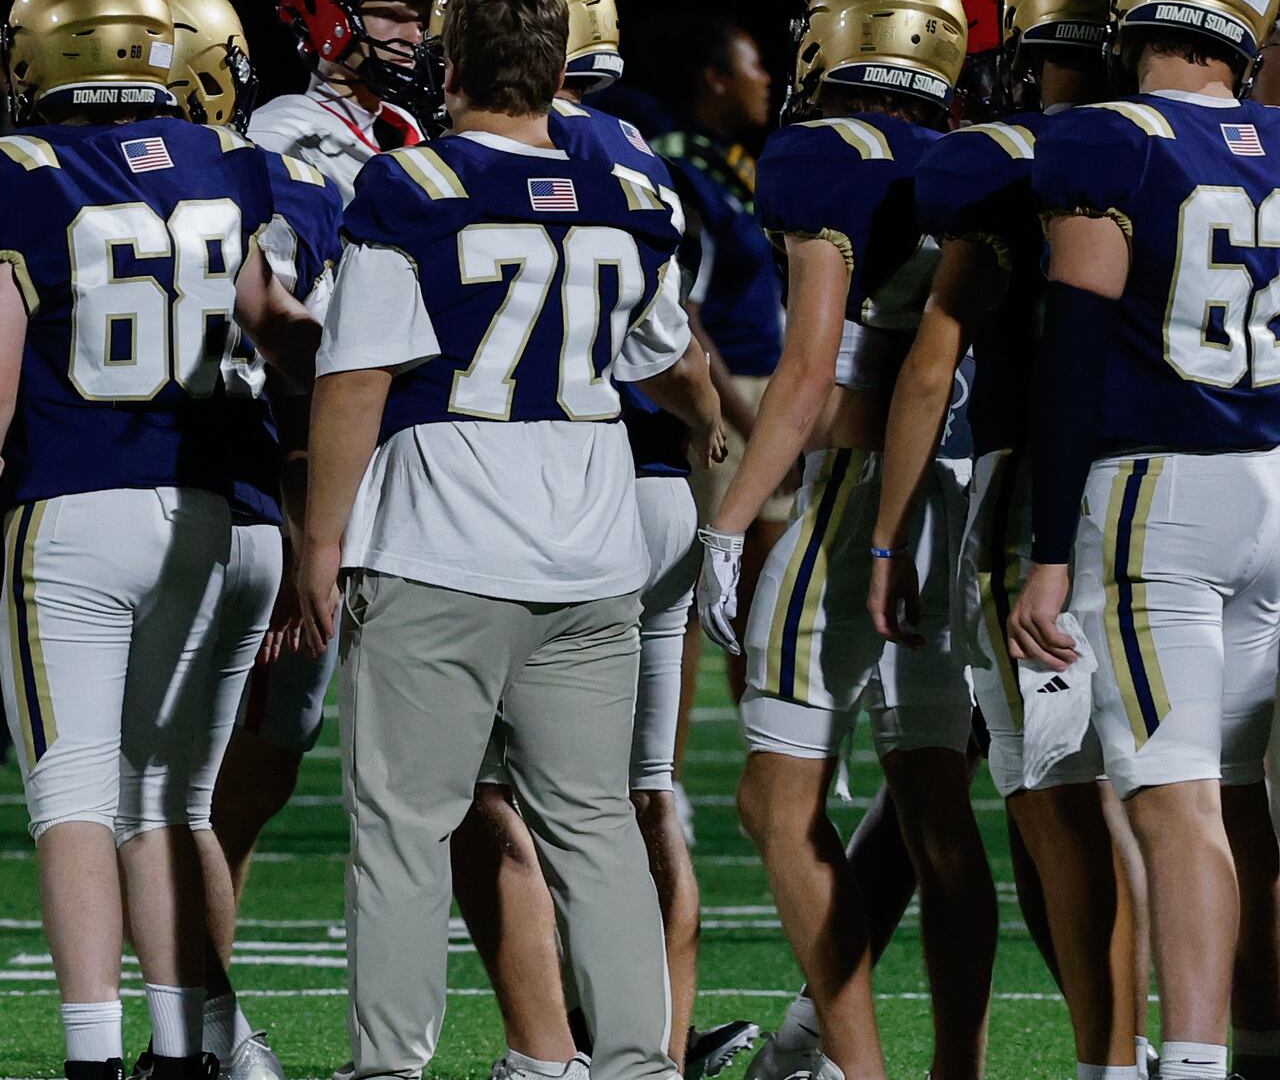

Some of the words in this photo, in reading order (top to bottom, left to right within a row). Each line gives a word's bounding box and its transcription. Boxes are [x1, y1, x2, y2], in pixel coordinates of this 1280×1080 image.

[1155, 4, 1204, 26] DOMINI
[1204, 13, 1245, 44] SUMUS
[131, 44, 142, 59] 68
[73, 88, 118, 104] DOMINI
[120, 88, 156, 103] SUMUS
[863, 67, 913, 88] DOMINI
[912, 73, 948, 99] SUMUS
[66, 198, 243, 402] 68
[447, 223, 646, 422] 70
